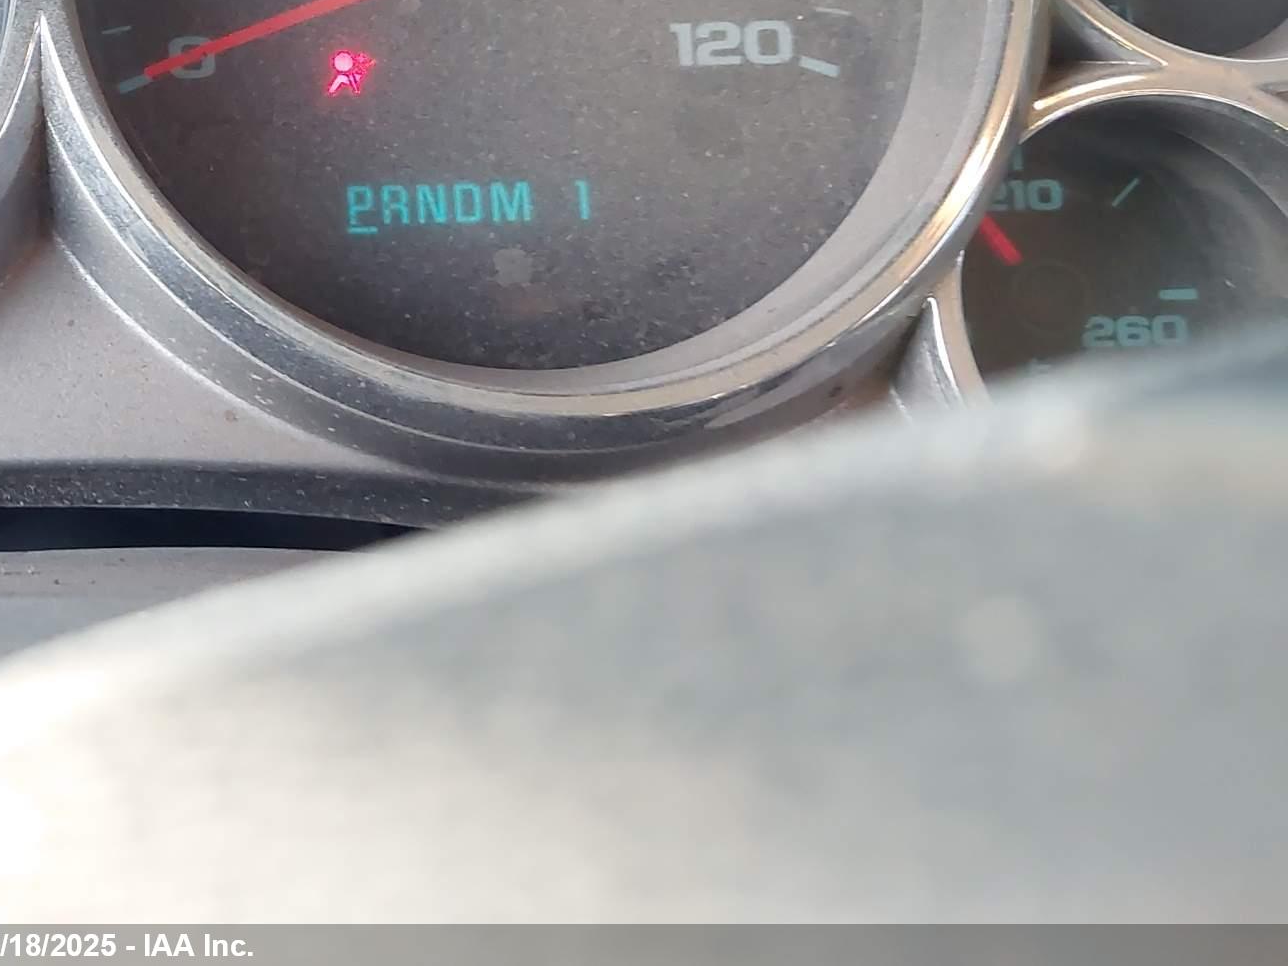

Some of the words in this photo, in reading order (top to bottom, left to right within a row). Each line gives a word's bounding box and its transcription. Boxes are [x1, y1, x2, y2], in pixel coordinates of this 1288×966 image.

[168, 35, 217, 79] 0
[669, 19, 794, 67] 120
[1082, 314, 1189, 347] 260
